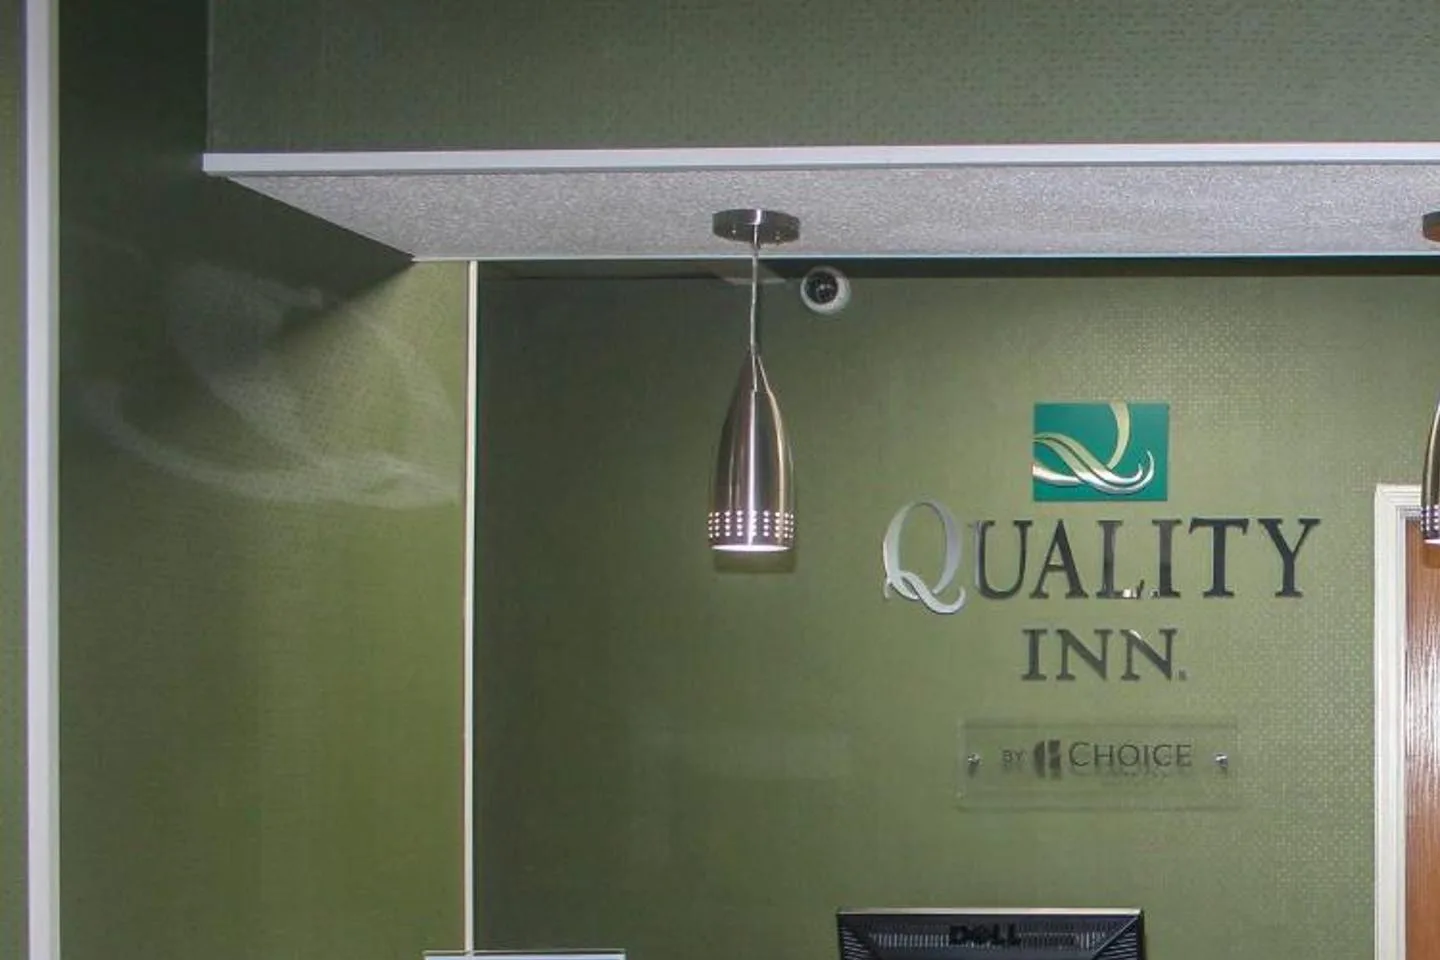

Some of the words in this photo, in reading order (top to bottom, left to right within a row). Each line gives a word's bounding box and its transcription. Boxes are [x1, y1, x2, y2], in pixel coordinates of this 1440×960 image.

[882, 500, 1321, 615] QUALITY
[1002, 749, 1026, 764] BY
[1068, 741, 1193, 768] CHOICE
